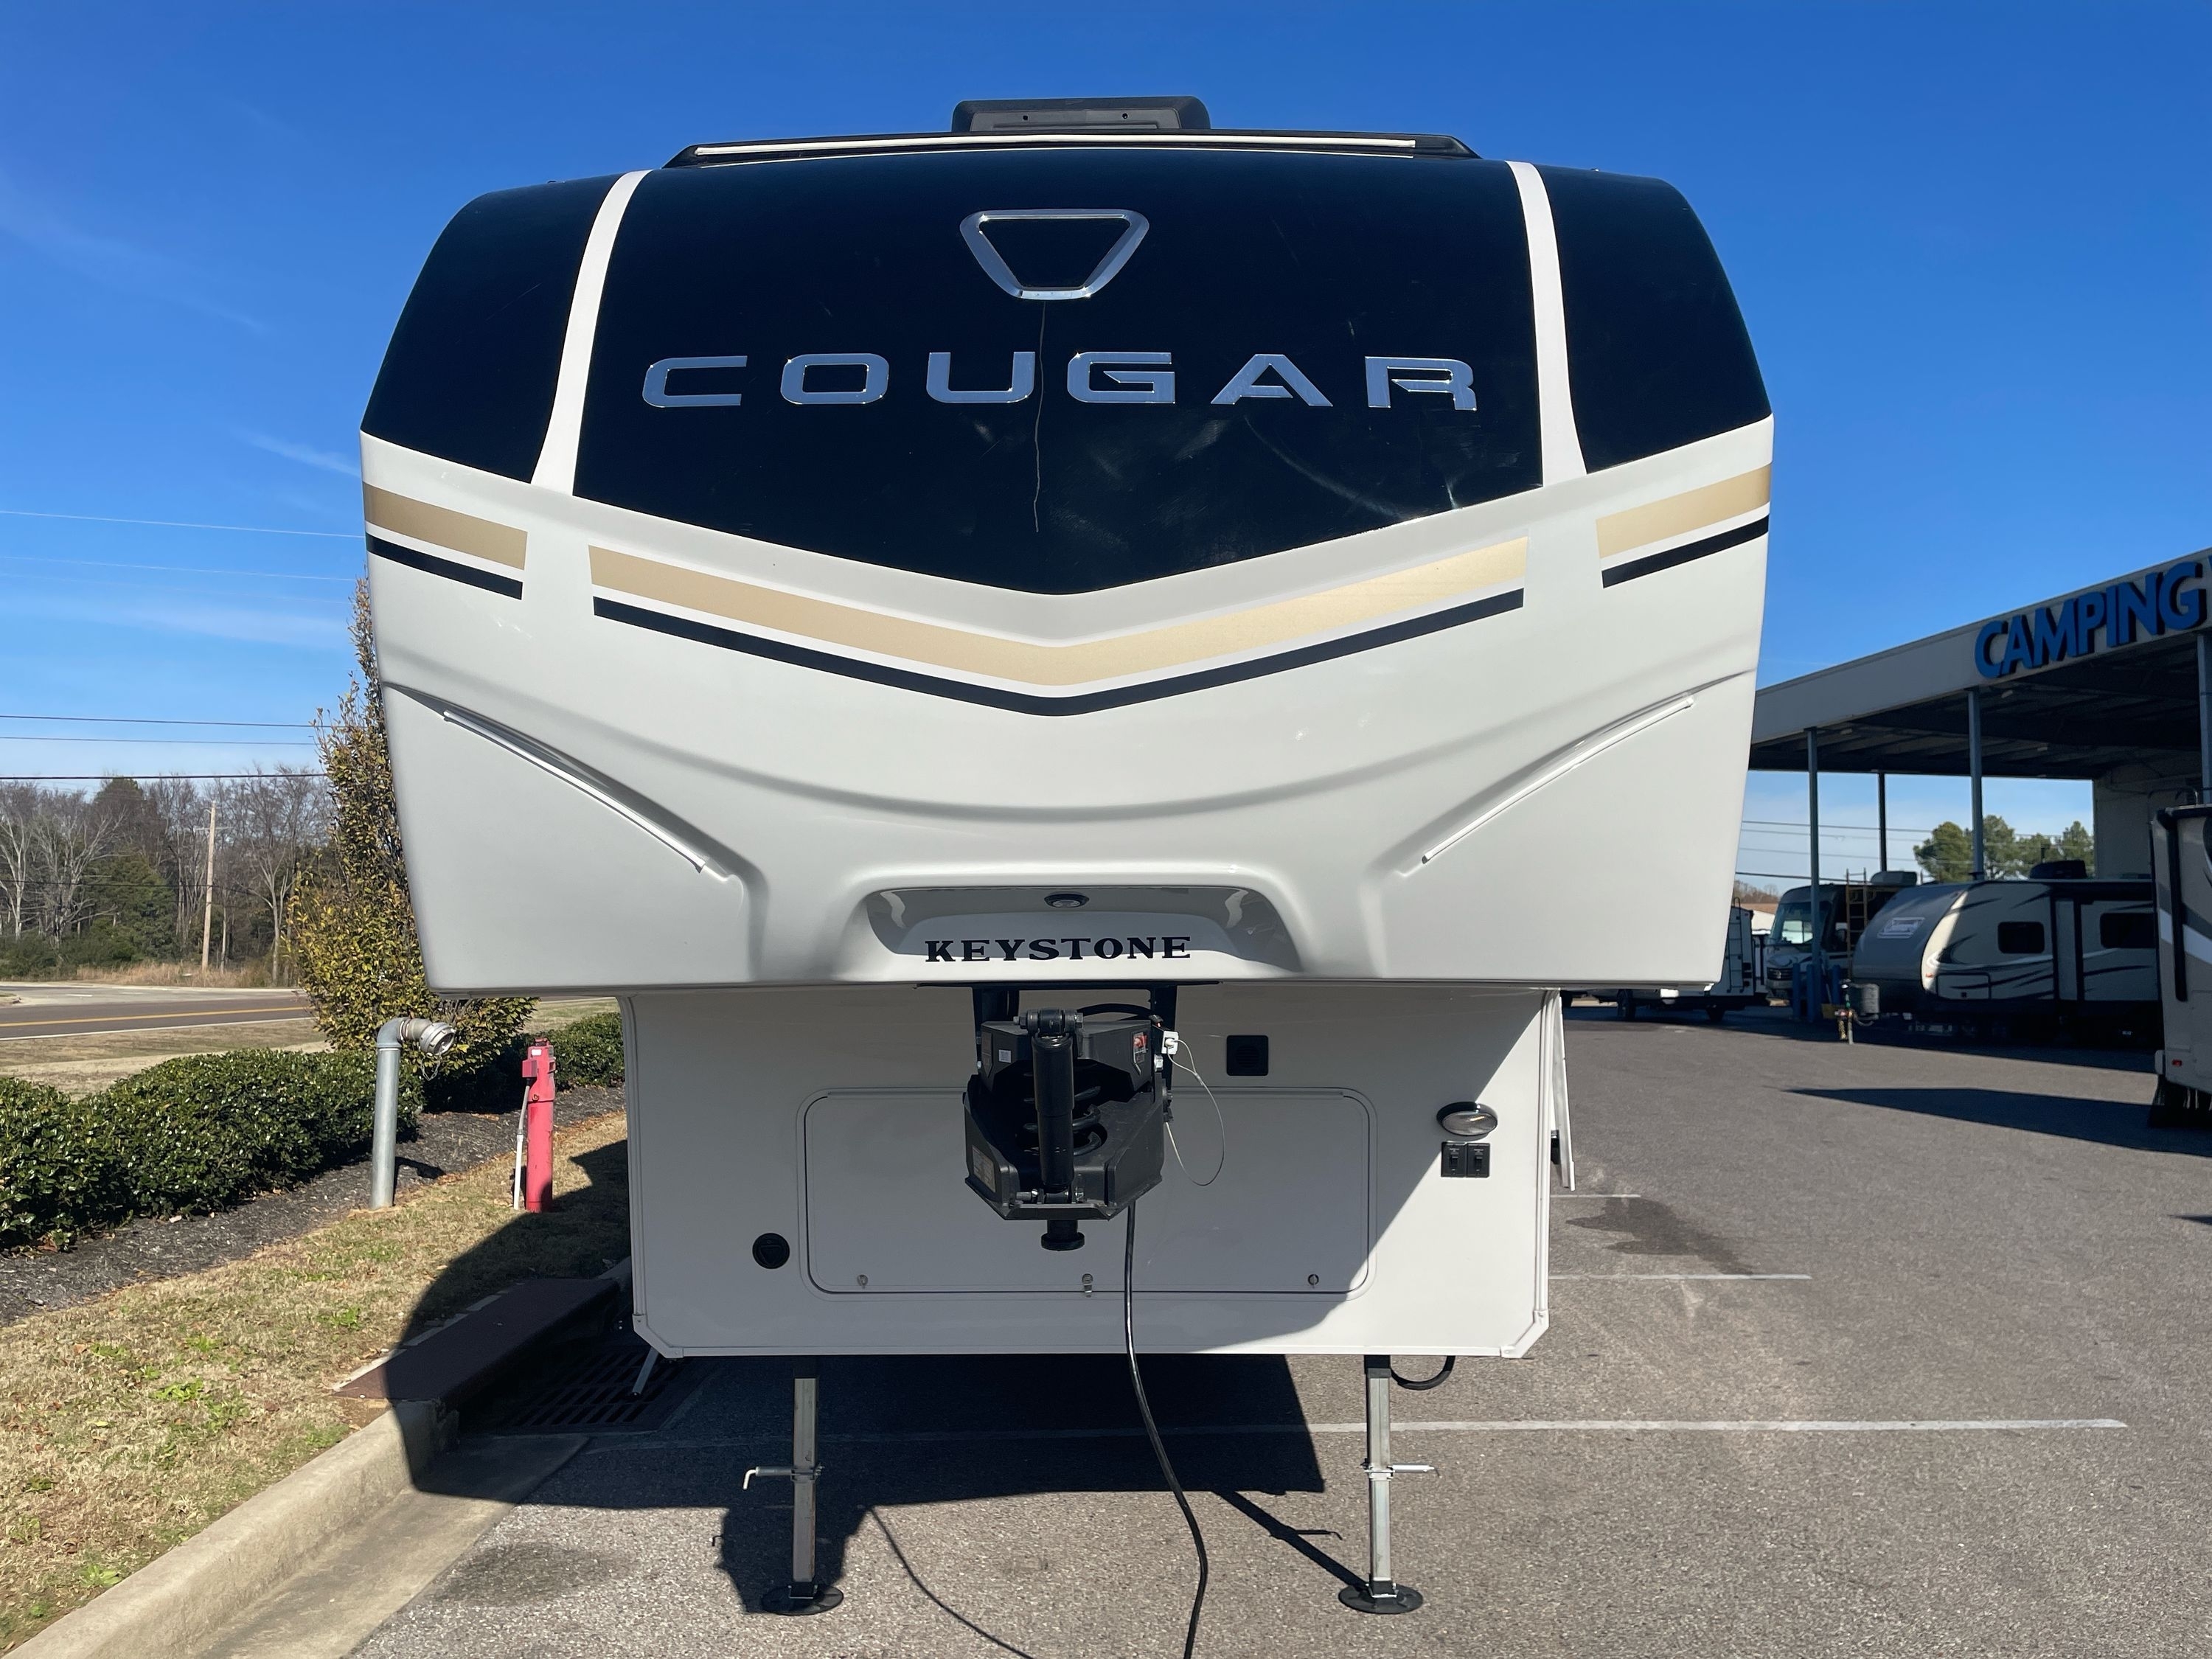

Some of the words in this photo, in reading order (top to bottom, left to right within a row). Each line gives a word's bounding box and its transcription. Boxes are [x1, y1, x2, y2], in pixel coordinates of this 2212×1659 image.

[642, 351, 1478, 411] COUGAR
[1975, 561, 2207, 678] CAMPING
[925, 936, 1191, 962] KEYSTONE
